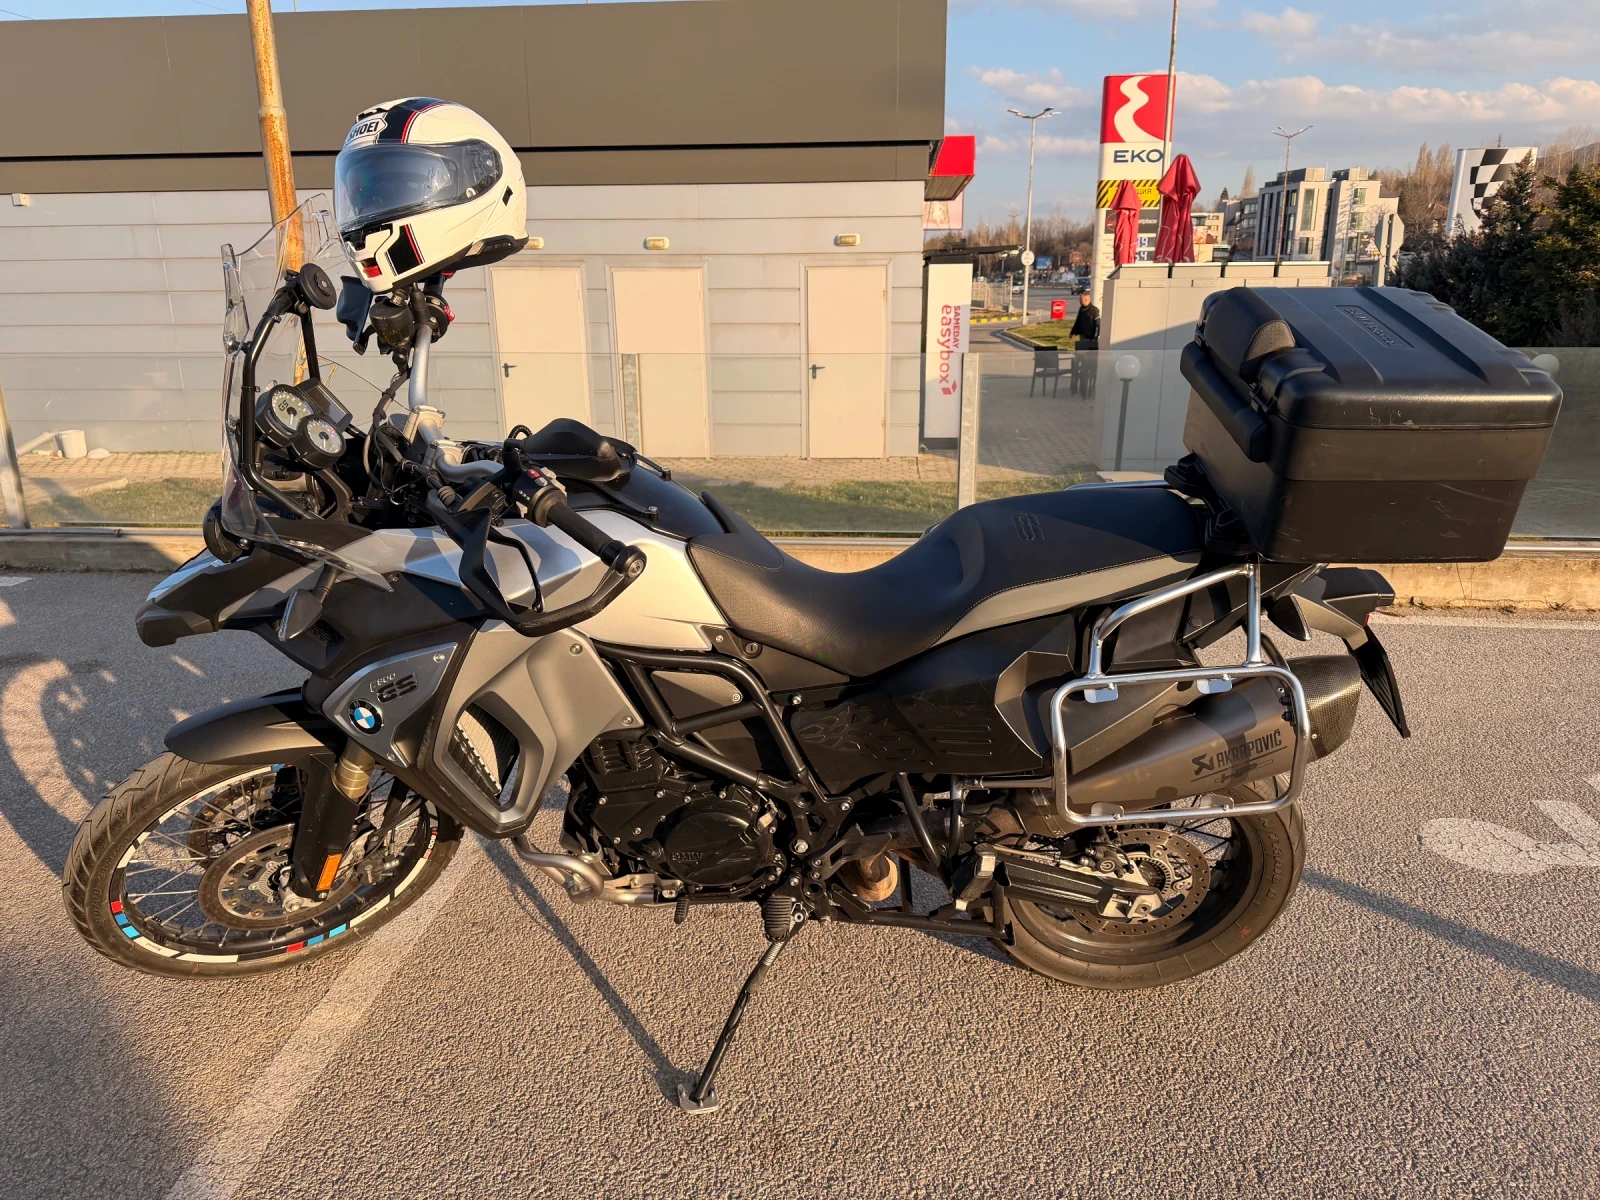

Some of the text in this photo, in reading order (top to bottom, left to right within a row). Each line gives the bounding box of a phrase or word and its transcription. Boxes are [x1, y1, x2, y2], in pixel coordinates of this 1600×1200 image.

[348, 120, 381, 139] SHOEI
[1113, 149, 1164, 163] EKO
[952, 305, 961, 349] SAMEDAY
[937, 304, 954, 384] easybox
